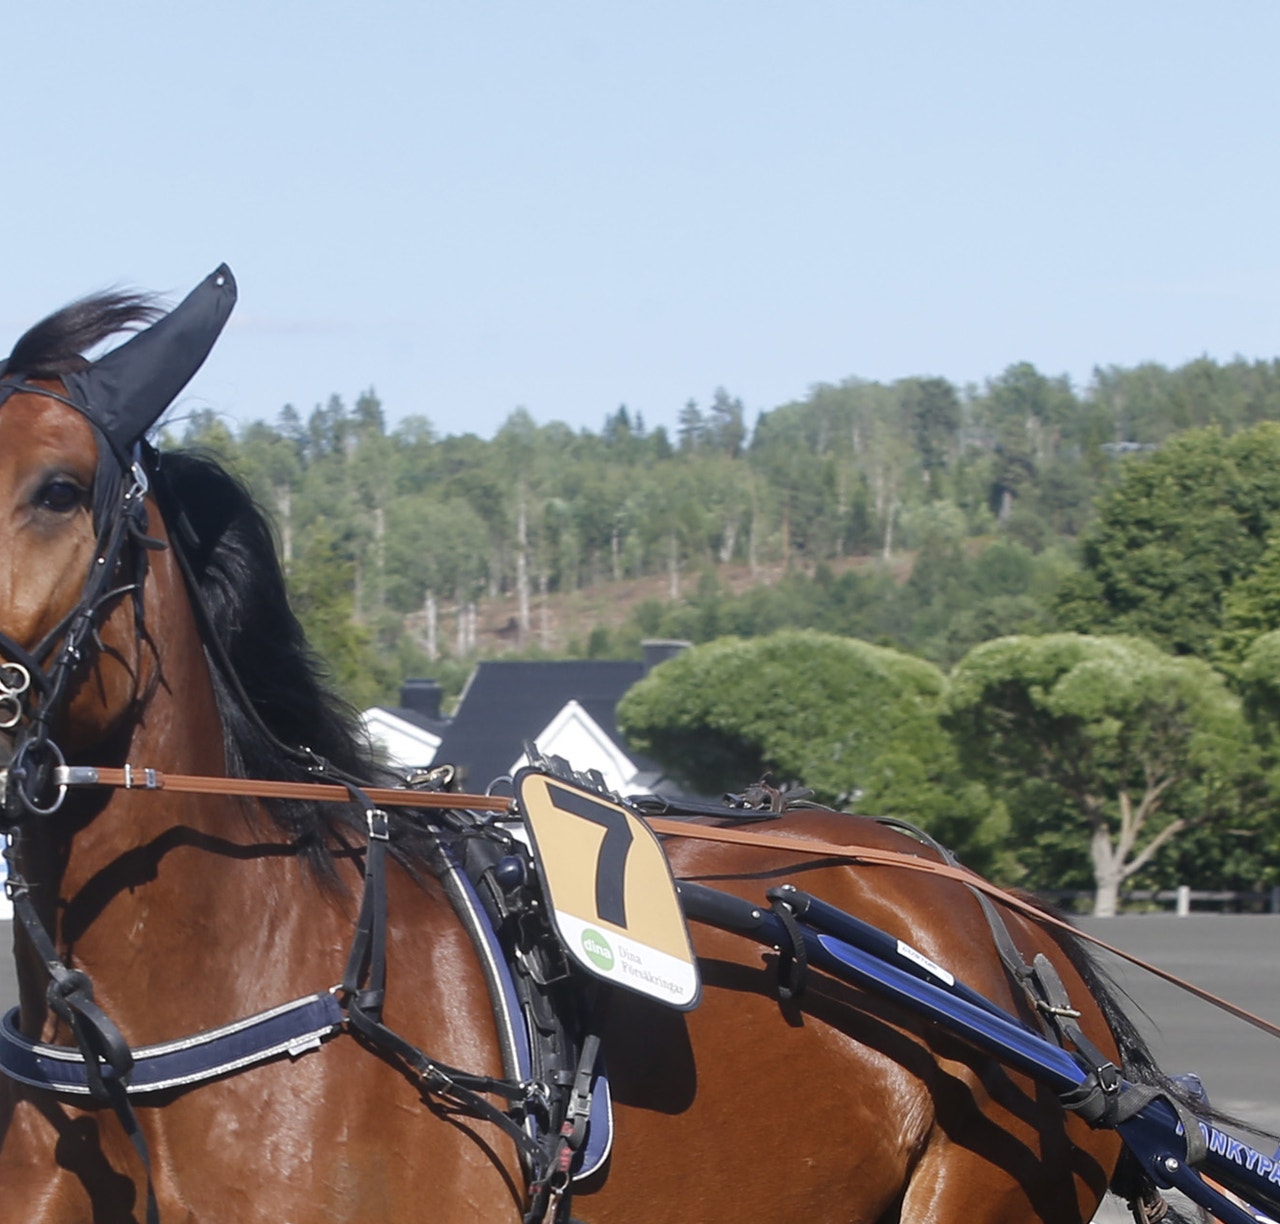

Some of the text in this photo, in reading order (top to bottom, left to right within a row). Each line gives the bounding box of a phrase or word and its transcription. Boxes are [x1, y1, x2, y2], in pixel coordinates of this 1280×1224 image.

[544, 781, 634, 930] 7
[583, 936, 613, 961] dina
[618, 945, 642, 966] Dina
